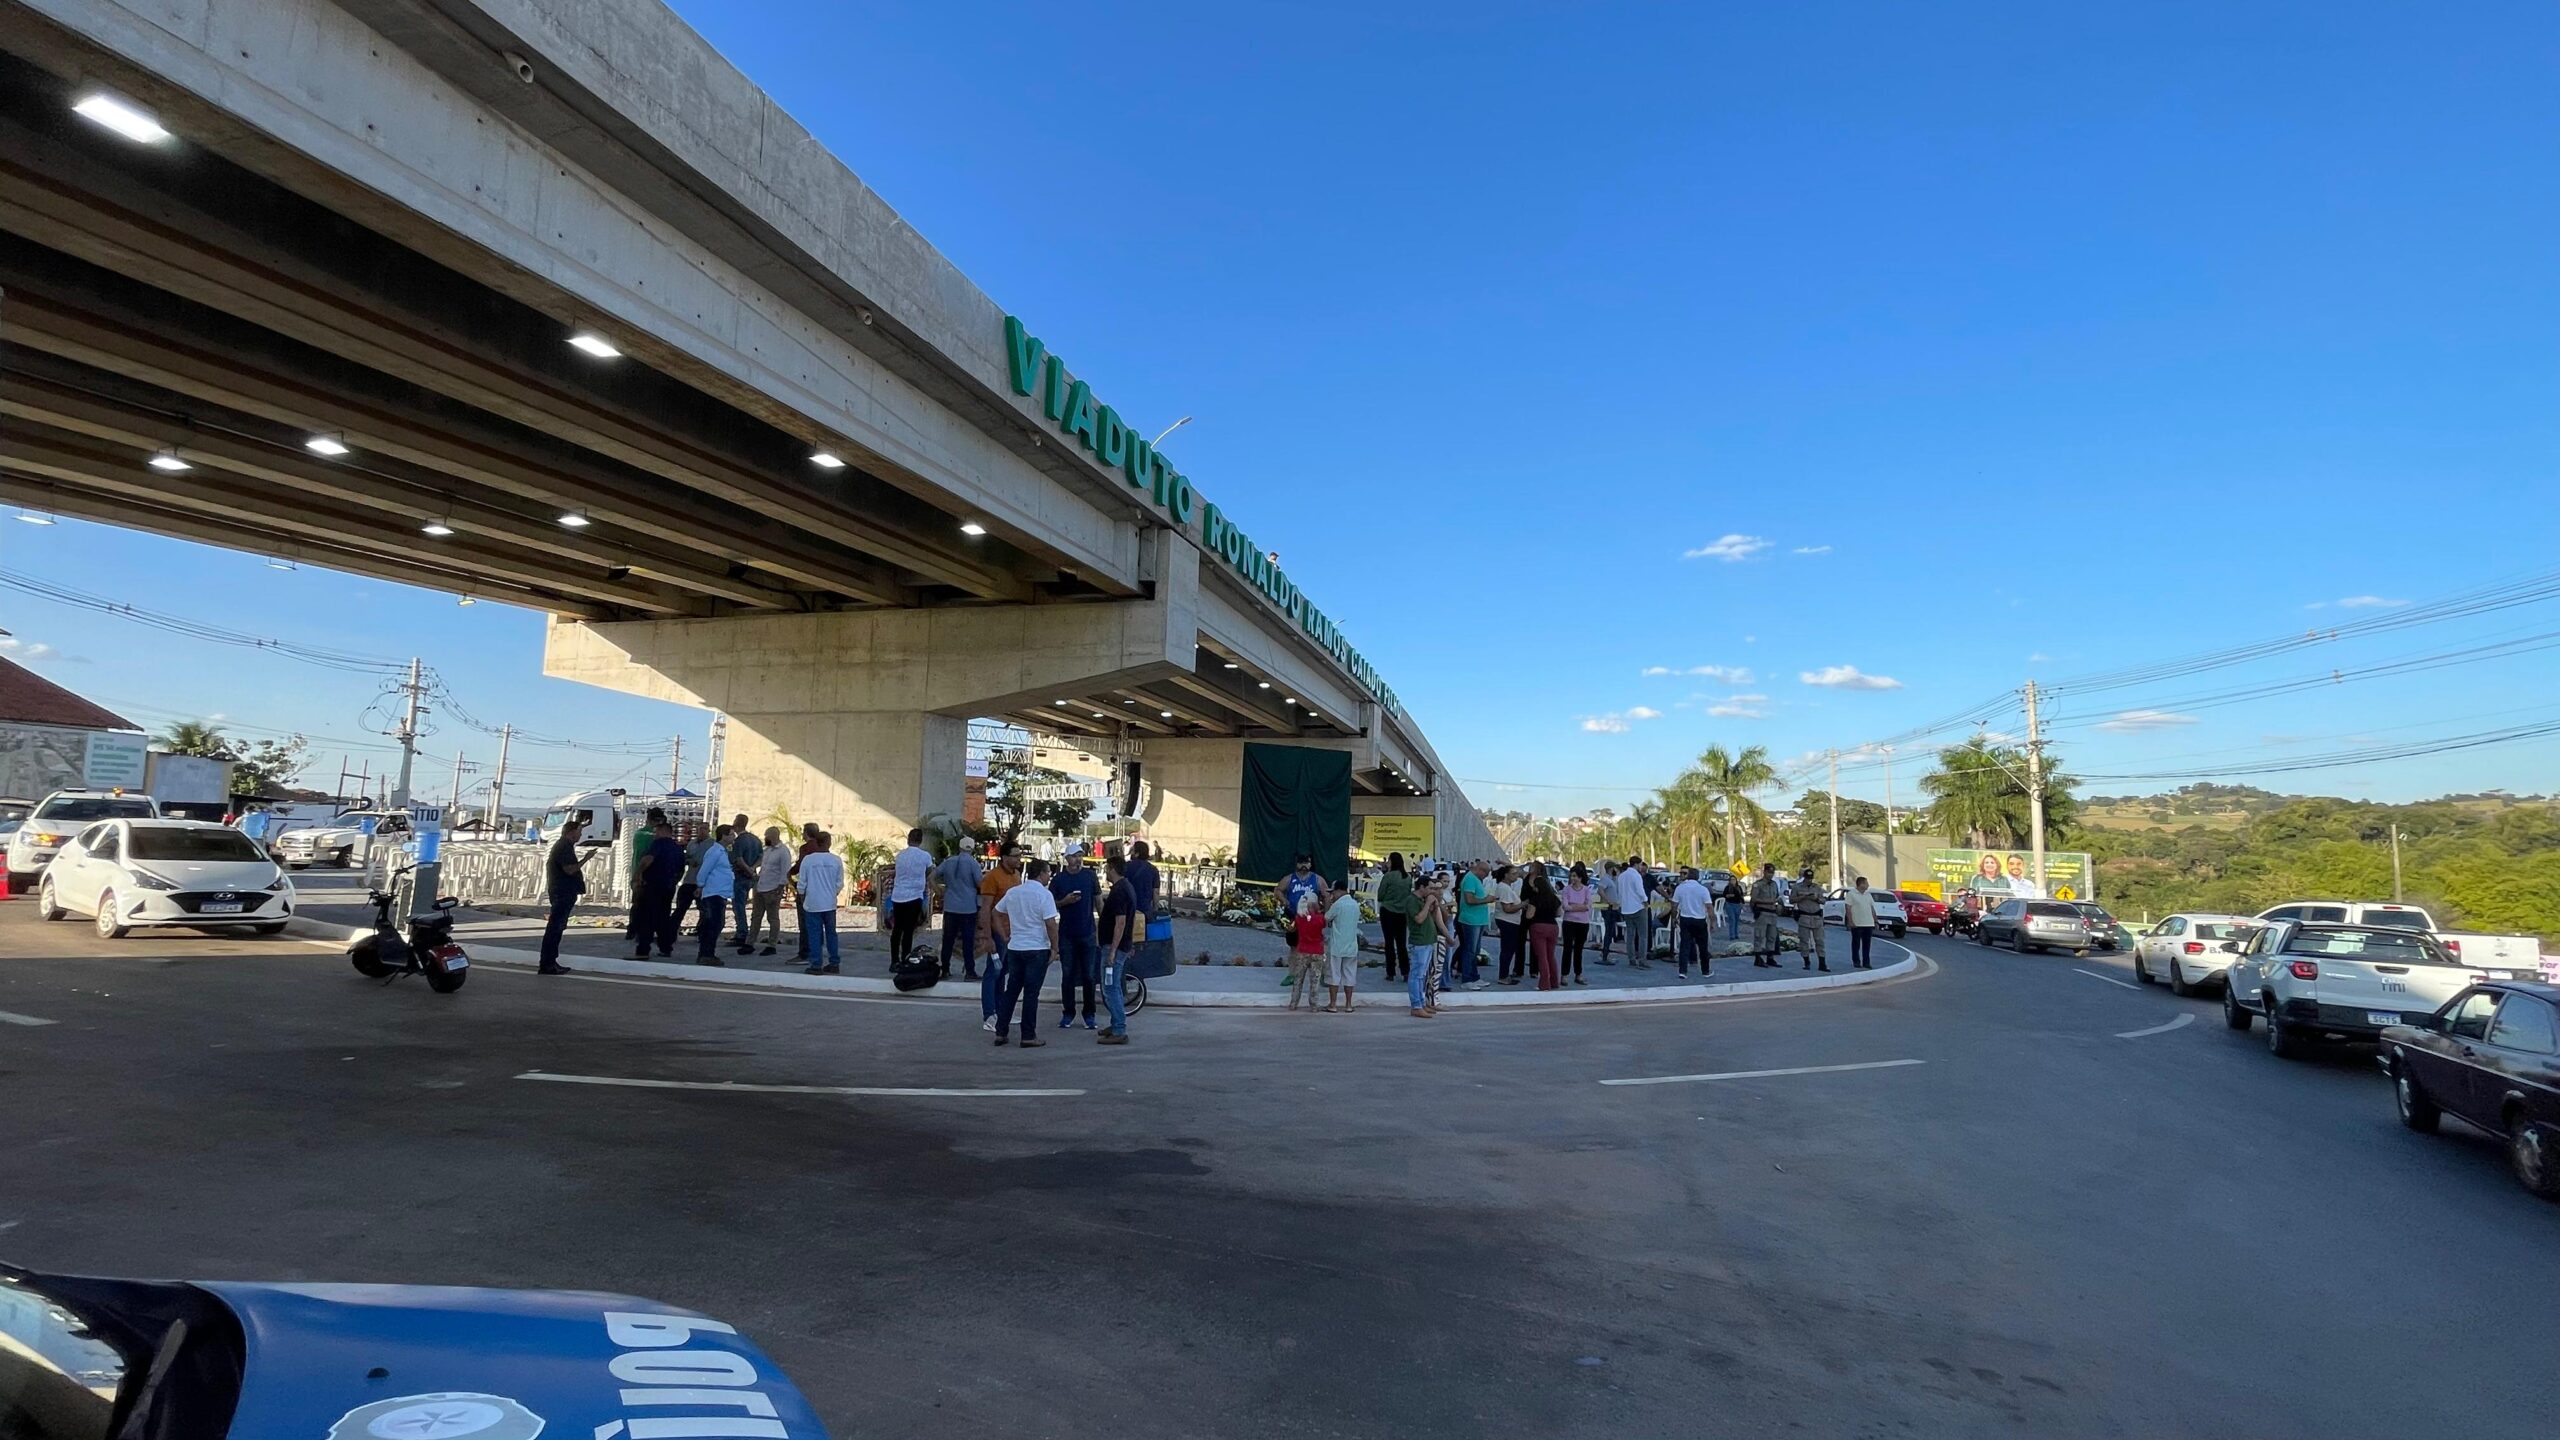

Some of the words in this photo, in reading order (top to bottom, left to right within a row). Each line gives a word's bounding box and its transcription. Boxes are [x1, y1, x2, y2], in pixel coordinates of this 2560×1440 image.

[1005, 316, 1192, 525] VIADUTO
[1204, 502, 1301, 619] RONALDO
[1302, 599, 1347, 662] RAMOS
[1348, 647, 1381, 698] CAIADO
[1381, 681, 1402, 719] FILHO
[1932, 863, 1974, 873] CAPITAL
